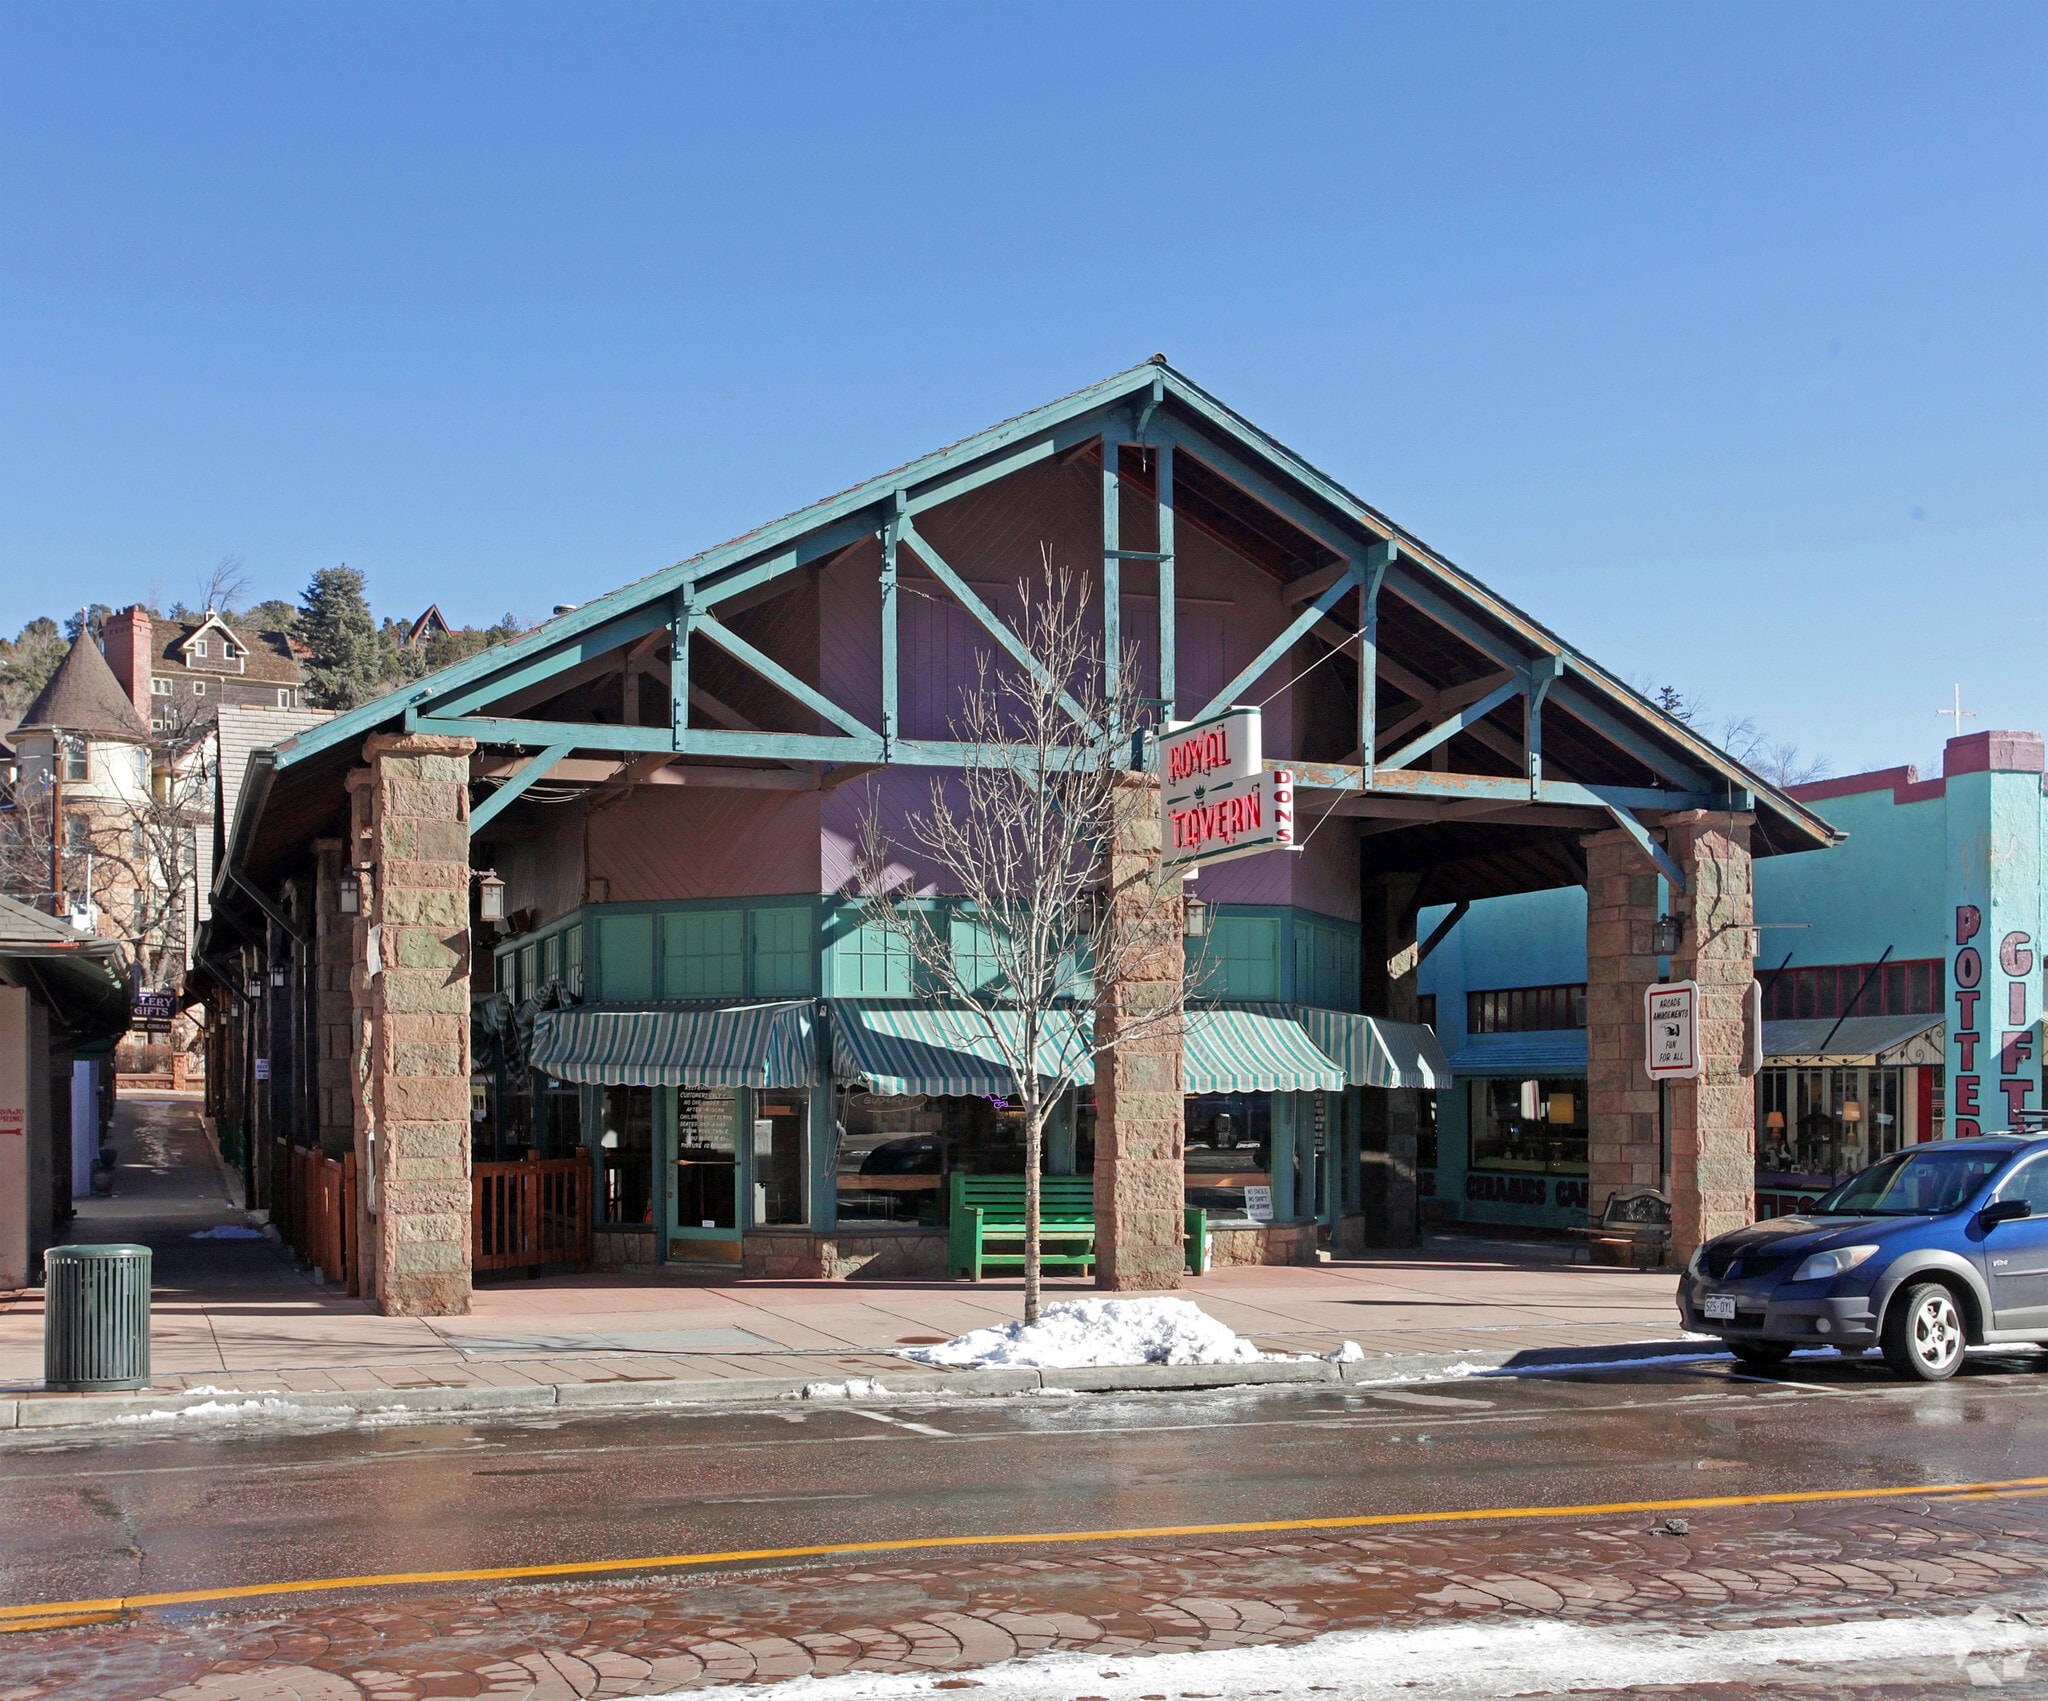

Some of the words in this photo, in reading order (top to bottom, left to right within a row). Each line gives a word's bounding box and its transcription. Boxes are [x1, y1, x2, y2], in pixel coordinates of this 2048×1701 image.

[1167, 729, 1231, 781] ROYAL
[1274, 771, 1292, 842] DONS
[1170, 790, 1261, 850] TAVERN
[139, 997, 174, 1006] LERY
[1659, 998, 1682, 1008] ARCADE
[133, 1006, 169, 1016] GIFTS
[1653, 1009, 1689, 1020] AMUSEMENTS
[1665, 1040, 1677, 1049] FUN
[1659, 1053, 1671, 1062] FOR
[1673, 1052, 1684, 1061] ALL
[1466, 1174, 1547, 1205] CERAMICS
